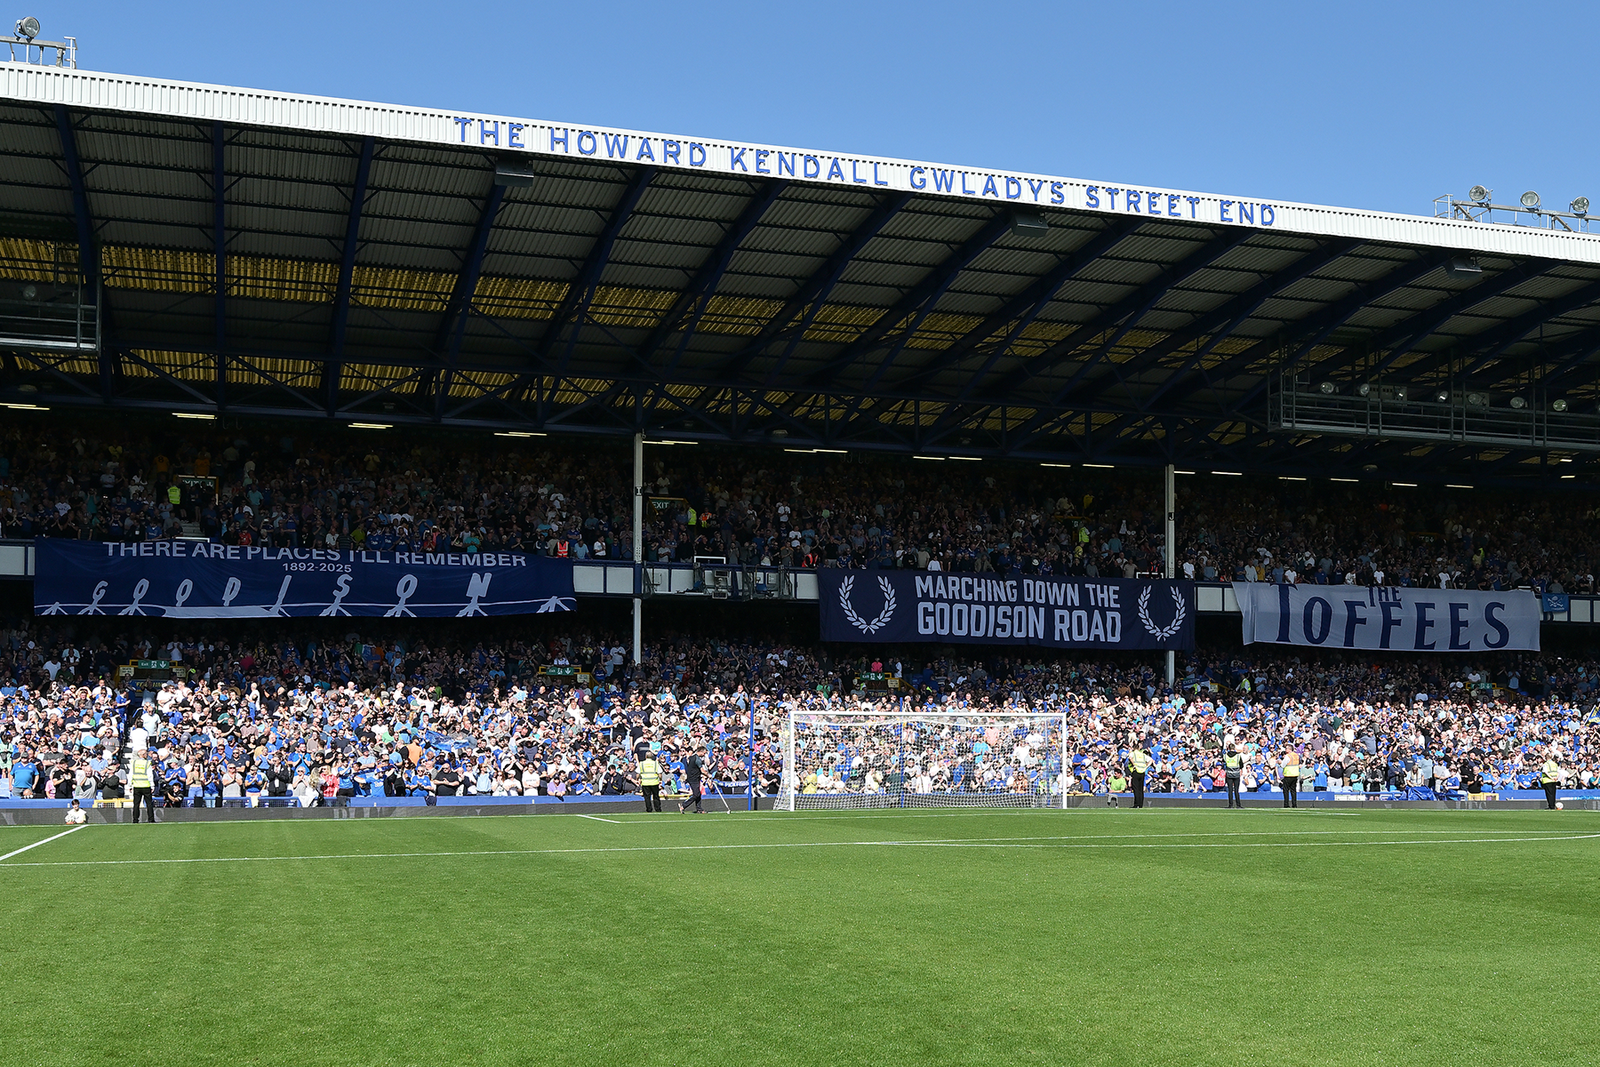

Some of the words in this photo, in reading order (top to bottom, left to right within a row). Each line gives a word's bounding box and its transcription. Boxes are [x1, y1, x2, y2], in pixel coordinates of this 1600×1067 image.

[453, 116, 525, 149] THE
[549, 127, 708, 168] HOWARD
[730, 147, 888, 187] KENDALL
[909, 166, 1066, 205] GWLADYS
[1085, 186, 1201, 219] STREET
[1219, 200, 1276, 227] END
[102, 541, 187, 558] THERE
[191, 542, 241, 560] ARE
[246, 546, 342, 562] PLACES
[395, 551, 527, 567] REMEMBER
[282, 562, 352, 573] 1892-2025
[915, 575, 1018, 603] MARCHING
[1023, 579, 1079, 605] DOWN
[1084, 583, 1121, 609] THE
[1365, 585, 1402, 607] THE
[917, 601, 1045, 639] GOODISON
[1054, 609, 1122, 643] ROAD
[1269, 583, 1510, 650] TOFFEES
